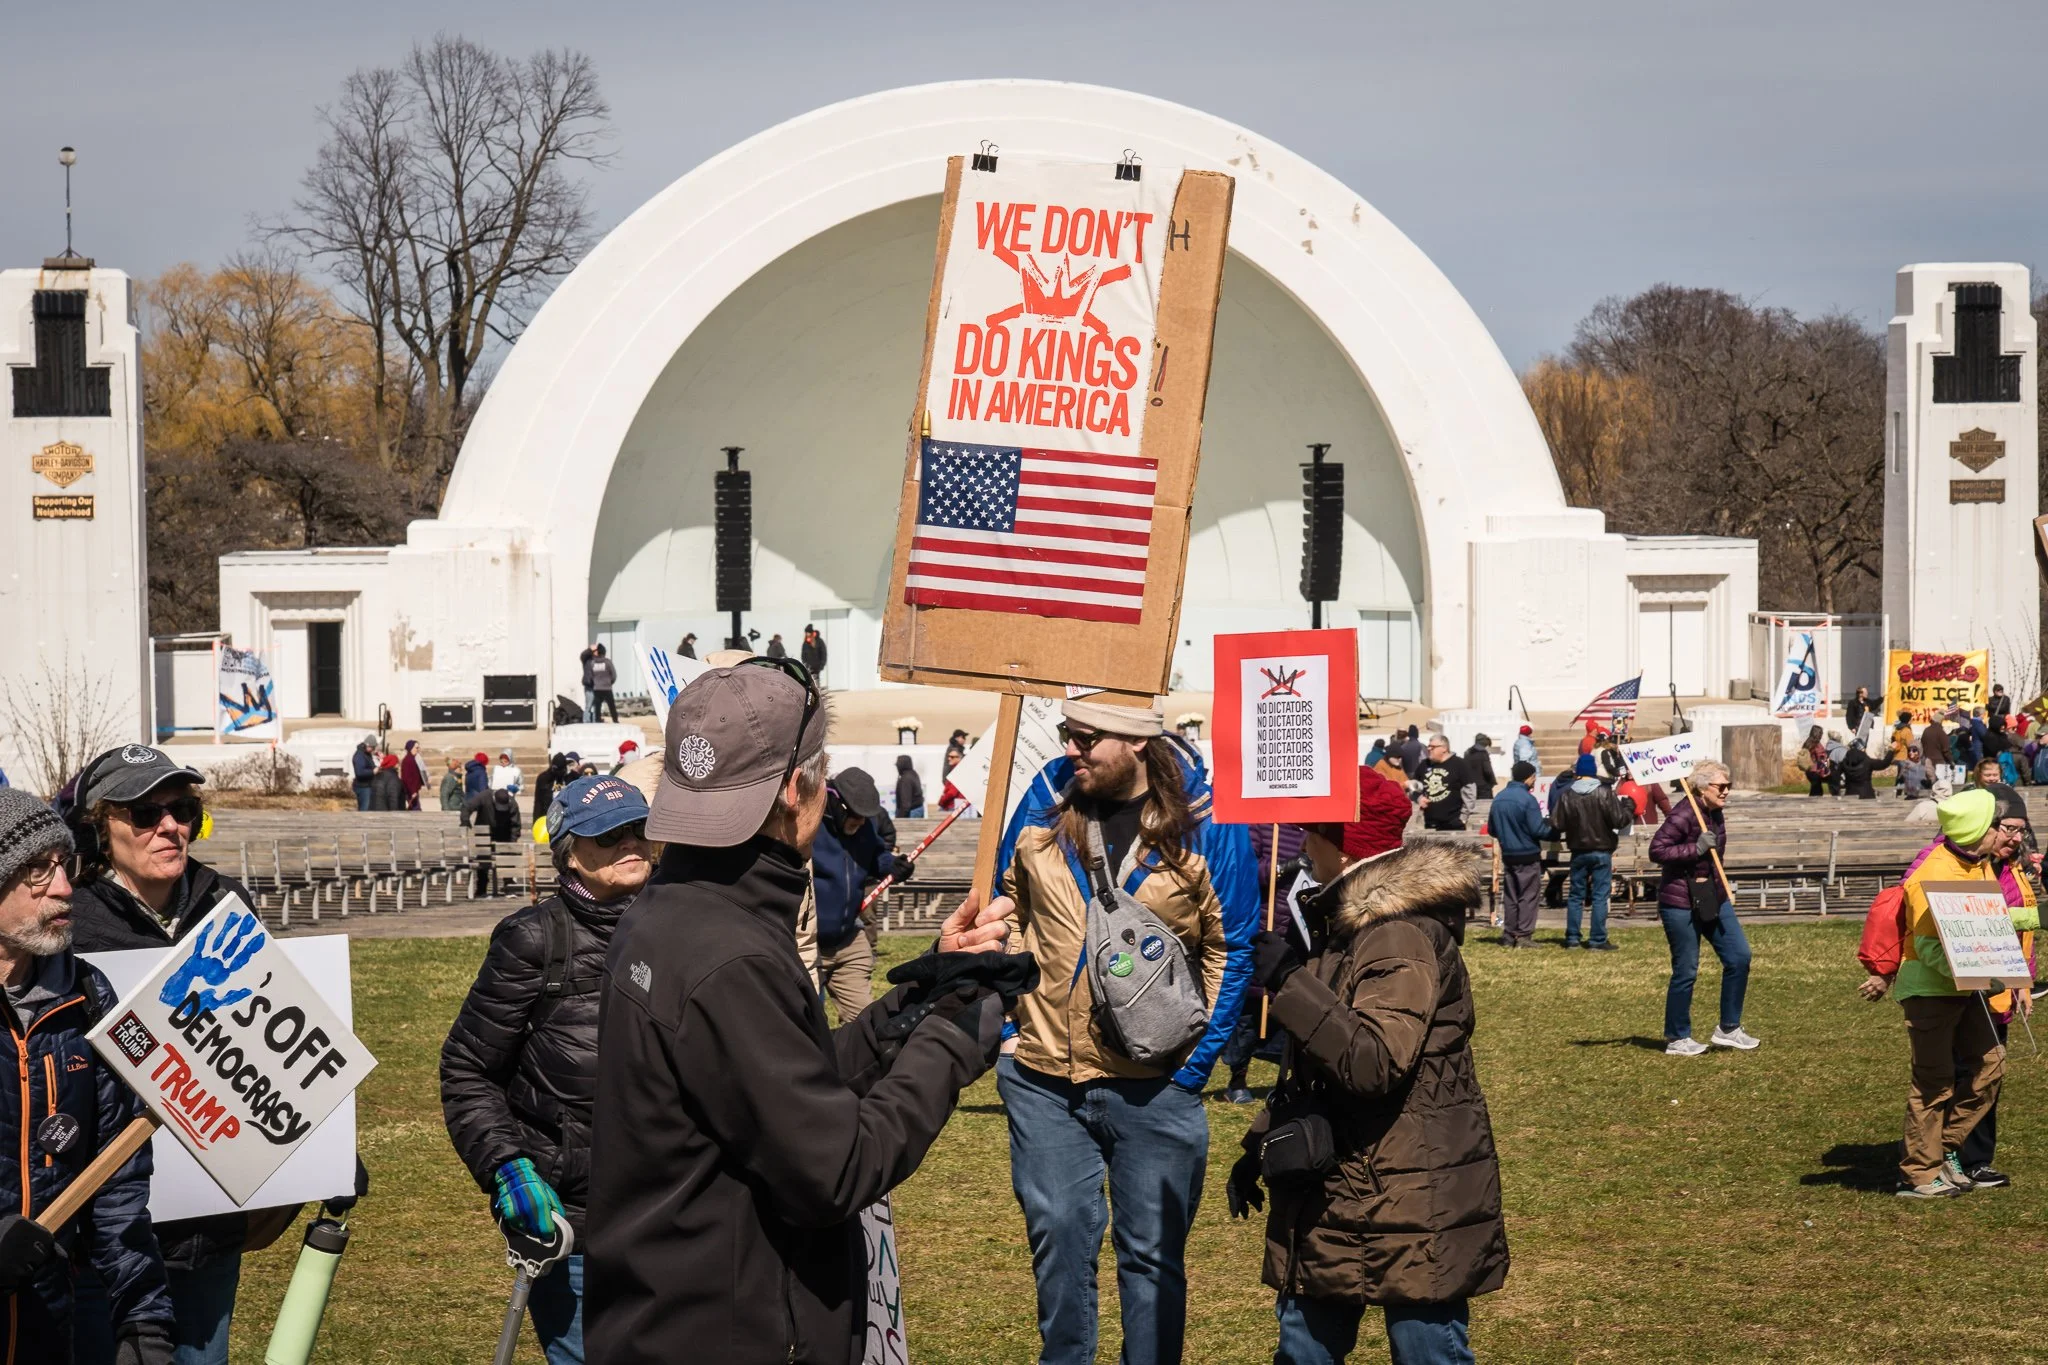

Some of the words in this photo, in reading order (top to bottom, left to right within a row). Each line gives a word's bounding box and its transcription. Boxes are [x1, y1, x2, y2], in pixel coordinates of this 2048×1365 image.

[976, 201, 1037, 252] WE
[1041, 205, 1154, 264] DON'T
[953, 323, 1011, 377] DO
[1017, 327, 1141, 391] KINGS
[947, 378, 982, 421] IN
[983, 380, 1131, 437] AMERICA
[48, 444, 77, 455] MOTOR
[34, 497, 77, 506] Supporting
[78, 496, 93, 505] Our
[36, 507, 91, 517] Neighborhood
[1898, 664, 1980, 683] SCHOOLS
[1900, 686, 1928, 701] NOT
[1028, 701, 1048, 720] KINGS
[1257, 702, 1267, 714] NO
[1268, 701, 1313, 714] DICTATORS
[1257, 716, 1267, 728] NO
[1268, 714, 1313, 728] DICTATORS
[1257, 729, 1267, 741] NO
[1268, 727, 1313, 741] DICTATORS
[1017, 732, 1048, 761] ORRUPTION
[1257, 742, 1267, 755] NO
[1268, 741, 1314, 754] DICTATORS
[1257, 756, 1267, 768] NO
[1268, 755, 1314, 768] DICTATORS
[1257, 769, 1267, 782] NO
[1268, 768, 1314, 781] DICTATORS
[581, 787, 600, 804] SAN
[604, 790, 624, 800] 1916
[1966, 895, 2000, 916] TRUMP
[1940, 919, 1976, 938] PROTECT
[115, 1025, 145, 1058] TRUMP
[124, 1019, 152, 1050] FCK
[264, 1005, 347, 1089] OFF
[168, 990, 312, 1145] DEMOCRACY
[150, 1042, 241, 1143] TRUMP
